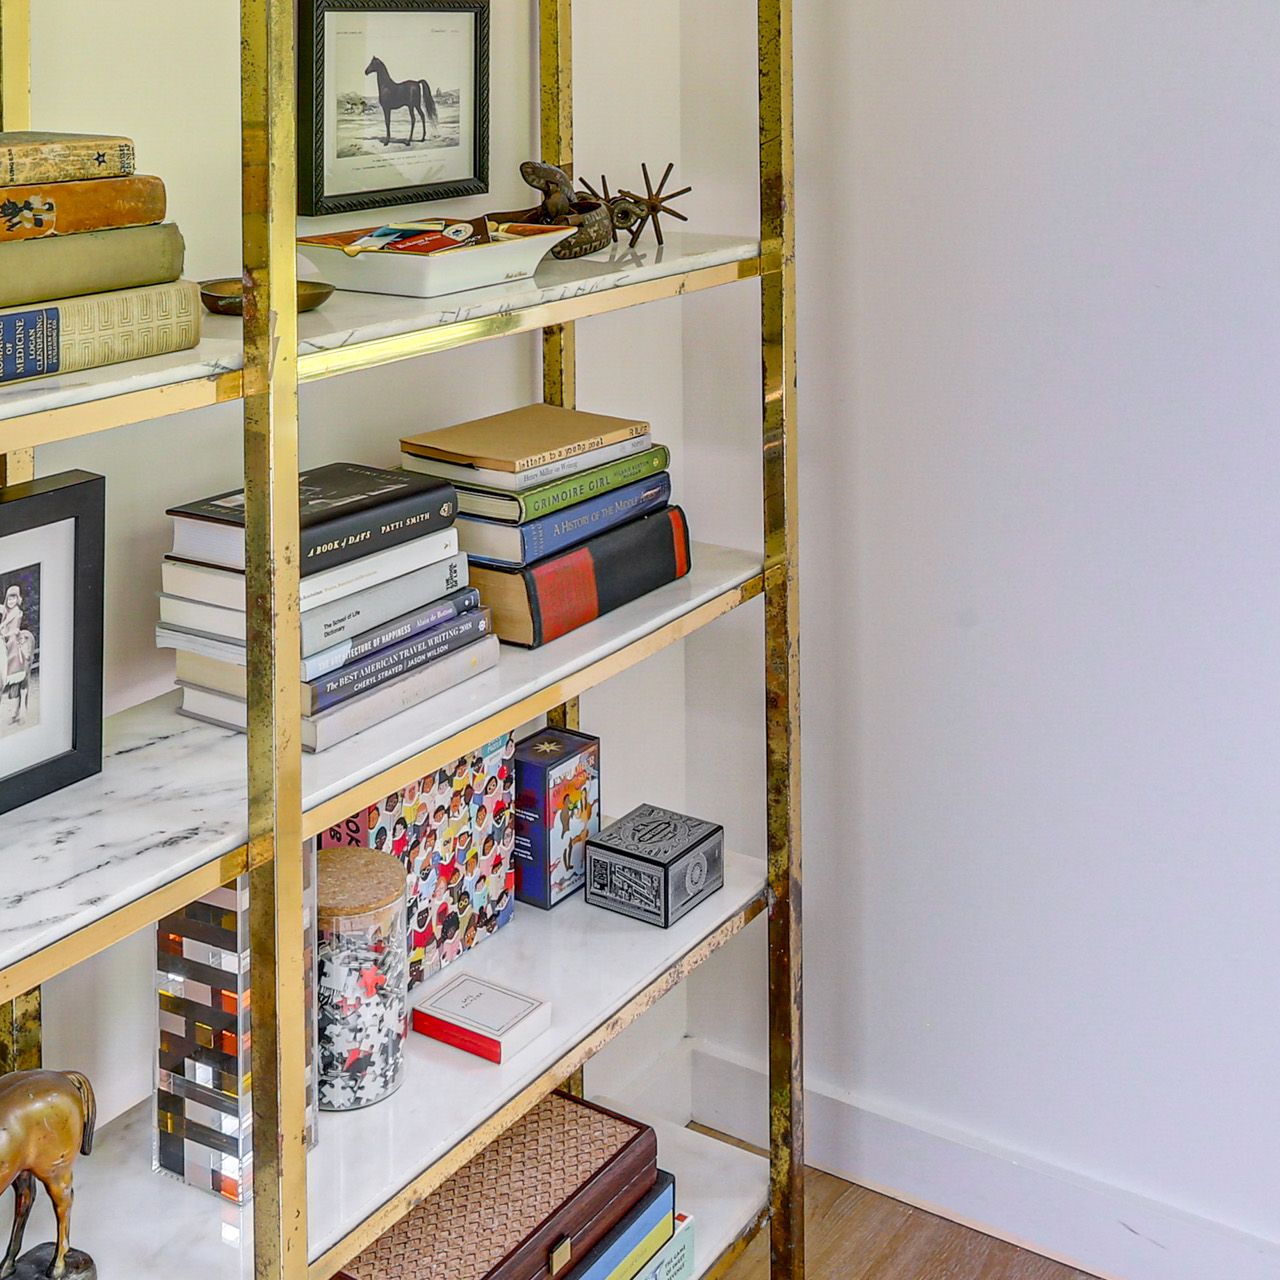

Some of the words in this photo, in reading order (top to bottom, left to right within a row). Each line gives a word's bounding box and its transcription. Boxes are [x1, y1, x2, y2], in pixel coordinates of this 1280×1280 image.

[6, 343, 13, 355] OF
[16, 318, 25, 373] MEDICINE
[564, 443, 586, 458] young
[588, 437, 604, 451] poet
[628, 425, 648, 437] RILKE
[533, 484, 585, 512] GRIMOIRE
[589, 475, 611, 492] GIRL
[307, 547, 314, 558] A
[316, 541, 340, 555] BOOK
[348, 531, 371, 545] DAYS
[381, 521, 404, 534] PATTI
[406, 512, 430, 526] SMITH
[554, 526, 561, 537] A
[323, 622, 332, 630] The
[332, 616, 346, 627] School
[346, 613, 352, 621] of
[352, 609, 361, 618] Life
[323, 624, 346, 639] Dictionary
[373, 636, 380, 648] OF
[382, 623, 412, 645] HAPPINESS
[325, 680, 338, 693] The
[339, 671, 360, 689] BEST
[359, 652, 399, 678] AMERICAN
[399, 640, 427, 661] TRAVEL
[427, 627, 459, 650] WRITING
[353, 675, 376, 692] CHERYL
[377, 664, 403, 682] STRAYED
[407, 655, 426, 669] JASON
[426, 644, 449, 660] WILSON
[673, 1244, 686, 1260] GAME
